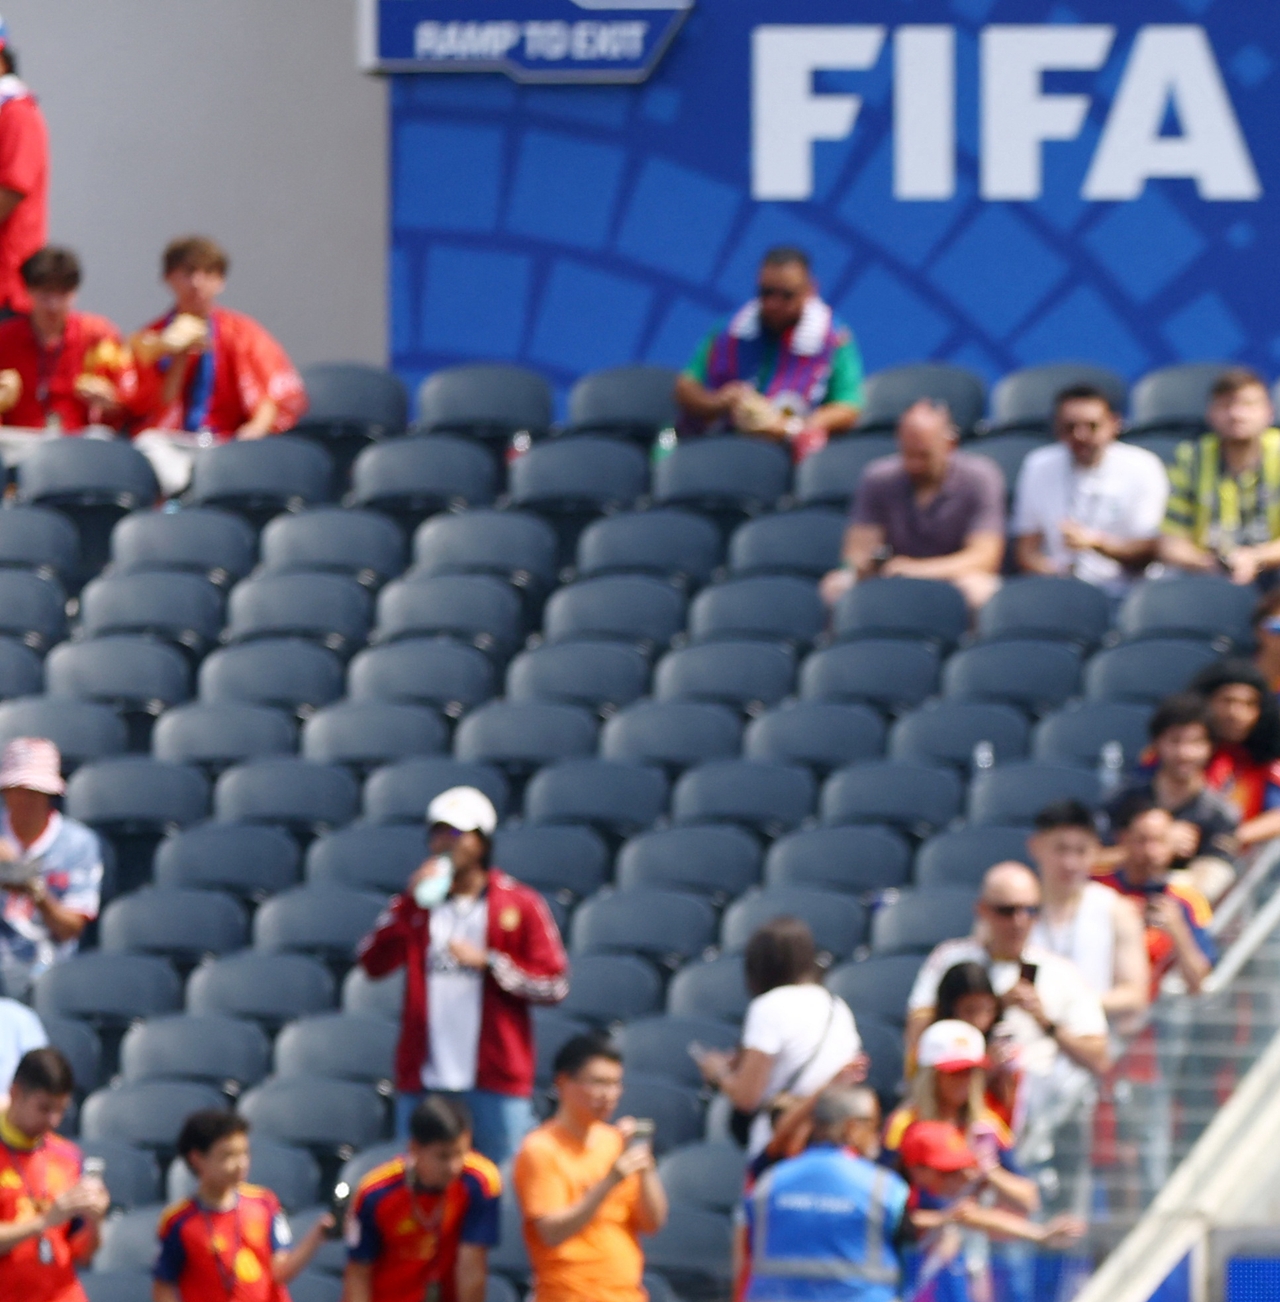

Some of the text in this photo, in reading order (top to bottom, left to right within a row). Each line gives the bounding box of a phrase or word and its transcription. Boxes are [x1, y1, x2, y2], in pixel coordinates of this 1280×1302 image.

[414, 20, 647, 60] RAMP TO EXIT
[751, 25, 1261, 200] FIFA
